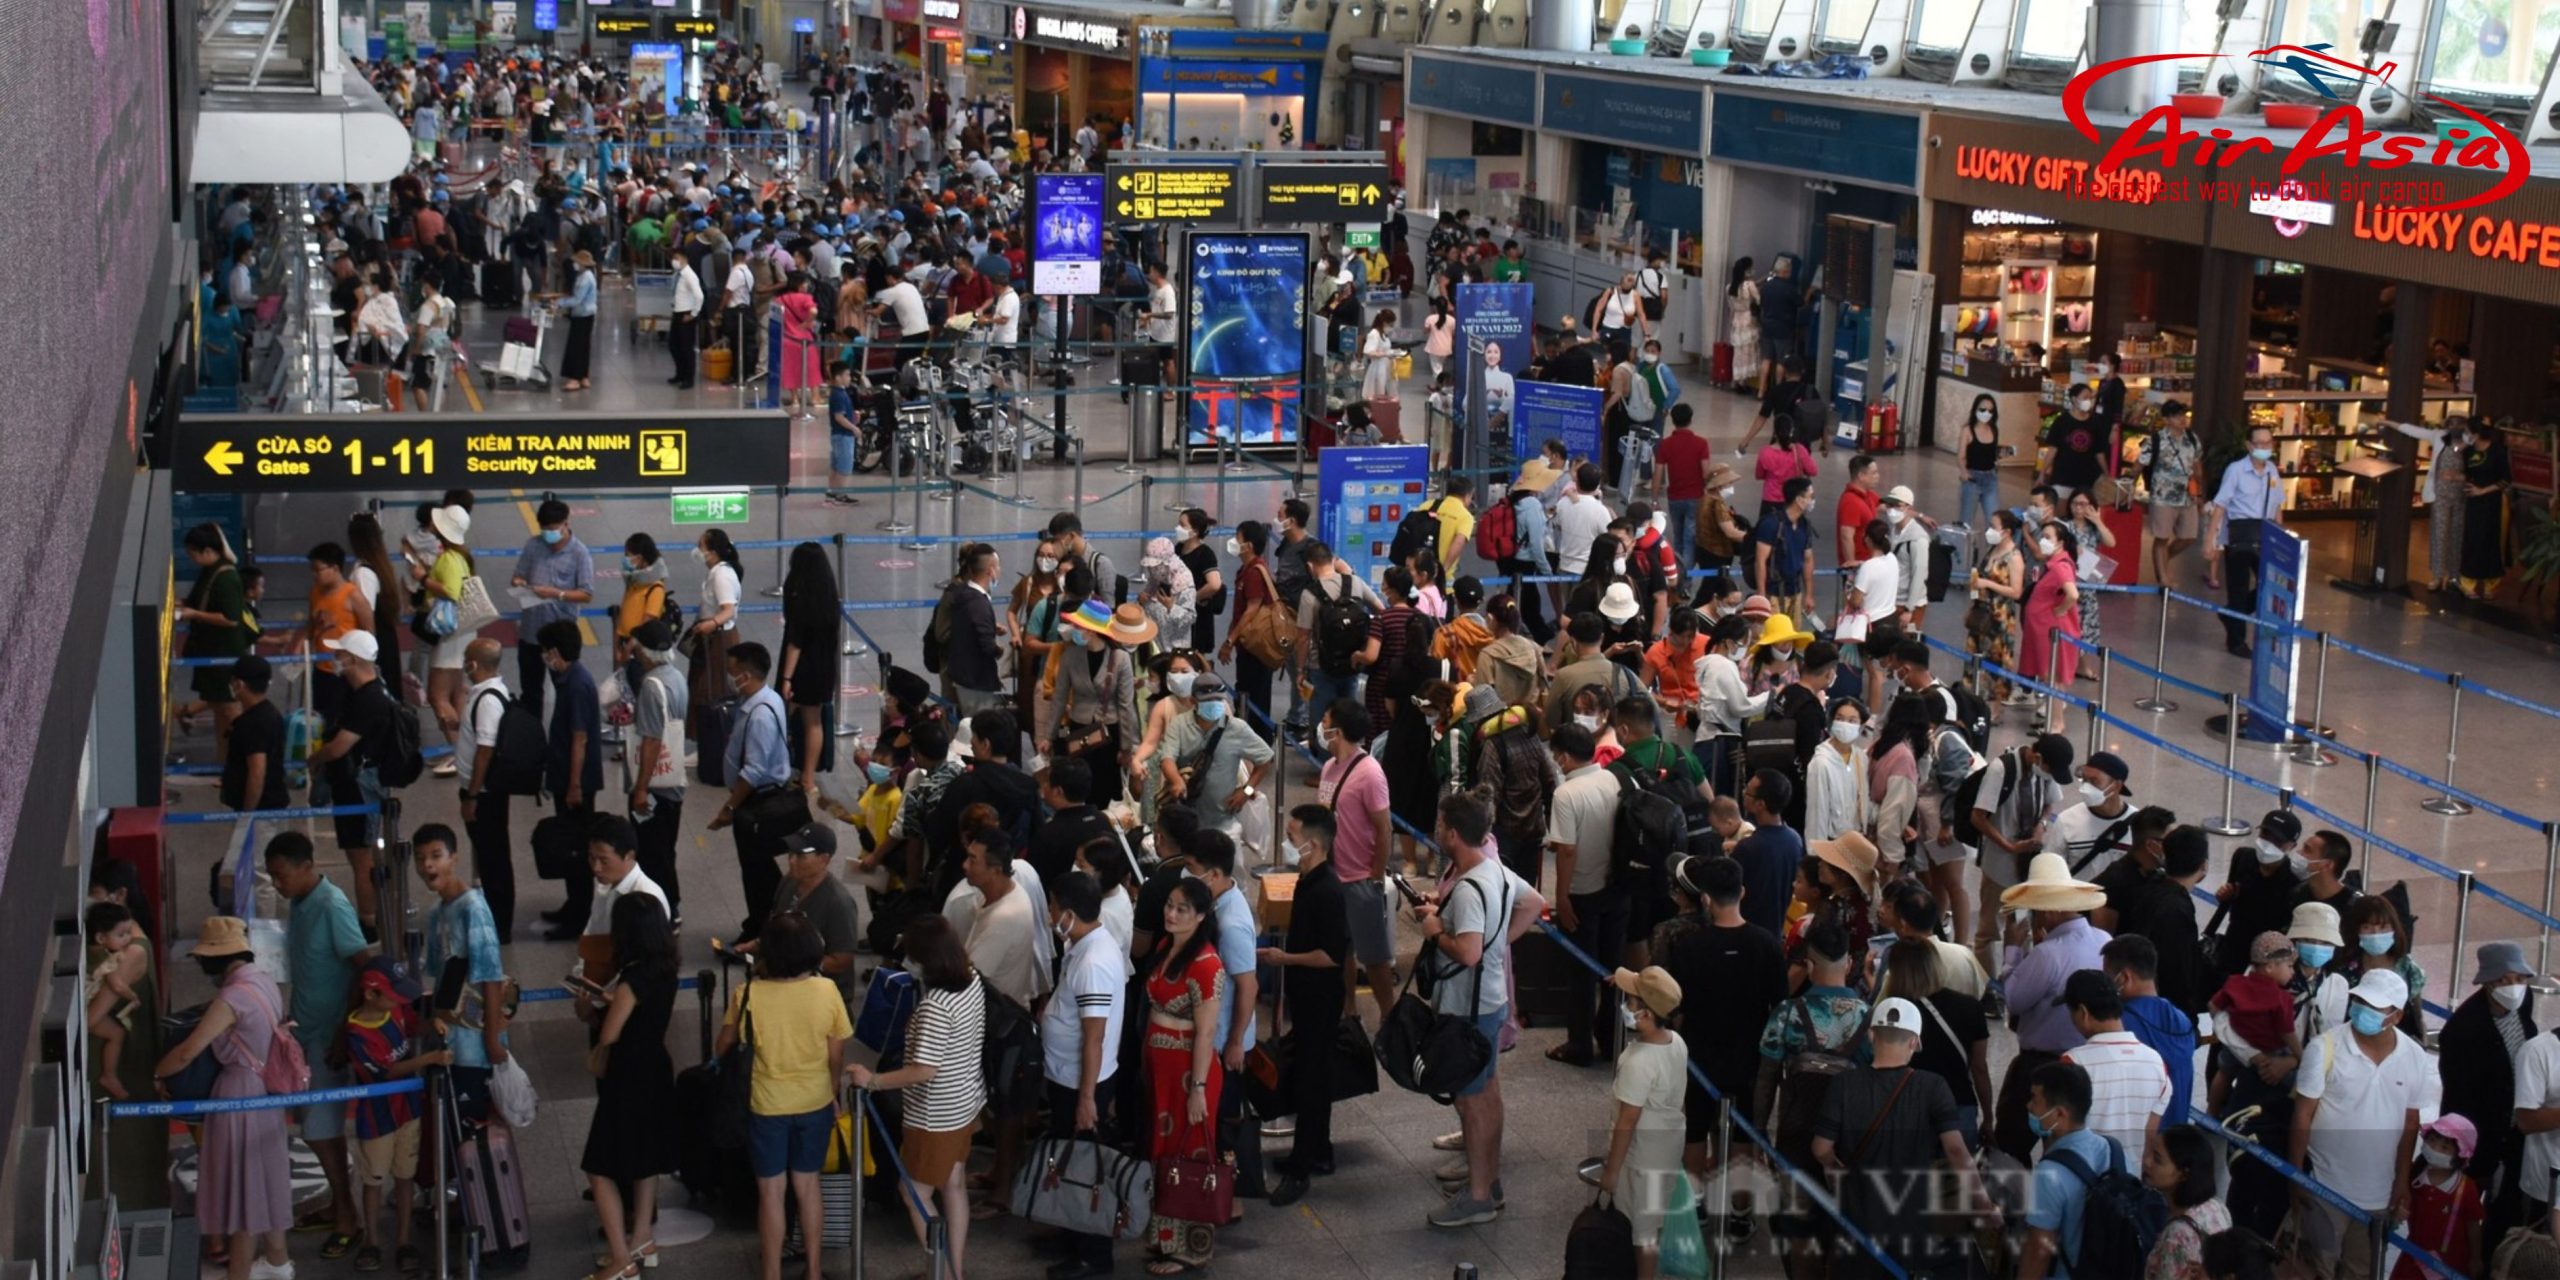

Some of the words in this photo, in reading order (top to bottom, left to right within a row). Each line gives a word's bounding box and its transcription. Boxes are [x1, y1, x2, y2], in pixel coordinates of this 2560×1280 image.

[1956, 145, 2031, 186] LUCKY
[2033, 156, 2089, 194] GIFT
[2093, 163, 2164, 205] SHOP
[1187, 208, 1211, 217] Check
[1351, 233, 1368, 245] EXIT
[2353, 199, 2464, 252] LUCKY
[2468, 215, 2560, 269] CAFE
[256, 433, 301, 454] CỬA
[304, 434, 332, 454] SỐ
[466, 433, 514, 453] KIỂM
[516, 435, 559, 452] TRA
[556, 435, 584, 452] AN
[587, 434, 631, 451] NINH
[256, 458, 311, 476] Gates
[466, 455, 539, 474] Security
[541, 454, 596, 472] Check
[116, 1105, 139, 1115] NAM
[147, 1104, 174, 1115] CTCP
[194, 1100, 242, 1112] AIRPORTS
[242, 1093, 311, 1110] CORPORATION
[311, 1093, 324, 1103] OF
[325, 1087, 368, 1101] VIETNAM
